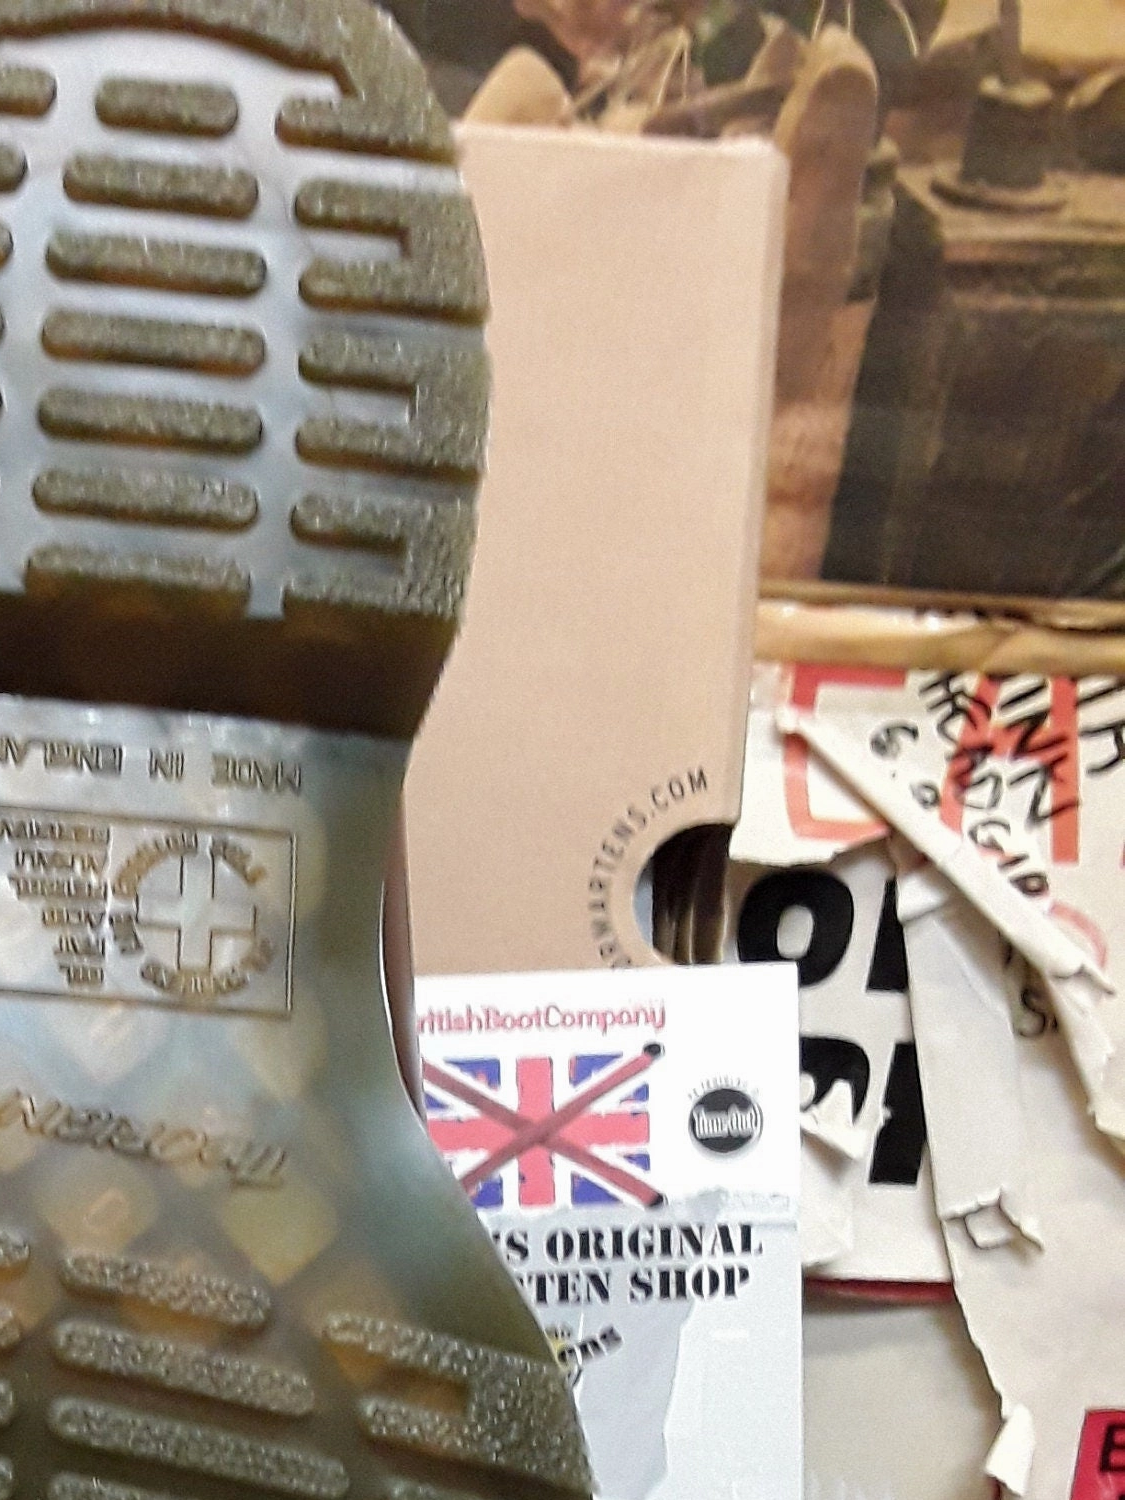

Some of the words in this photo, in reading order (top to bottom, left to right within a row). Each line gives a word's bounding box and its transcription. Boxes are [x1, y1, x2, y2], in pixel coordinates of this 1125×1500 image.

[416, 1003, 667, 1036] ritishBootCompany
[545, 1222, 763, 1263] ORIGINAL
[519, 1271, 612, 1305] TEN
[628, 1266, 752, 1302] SHOP
